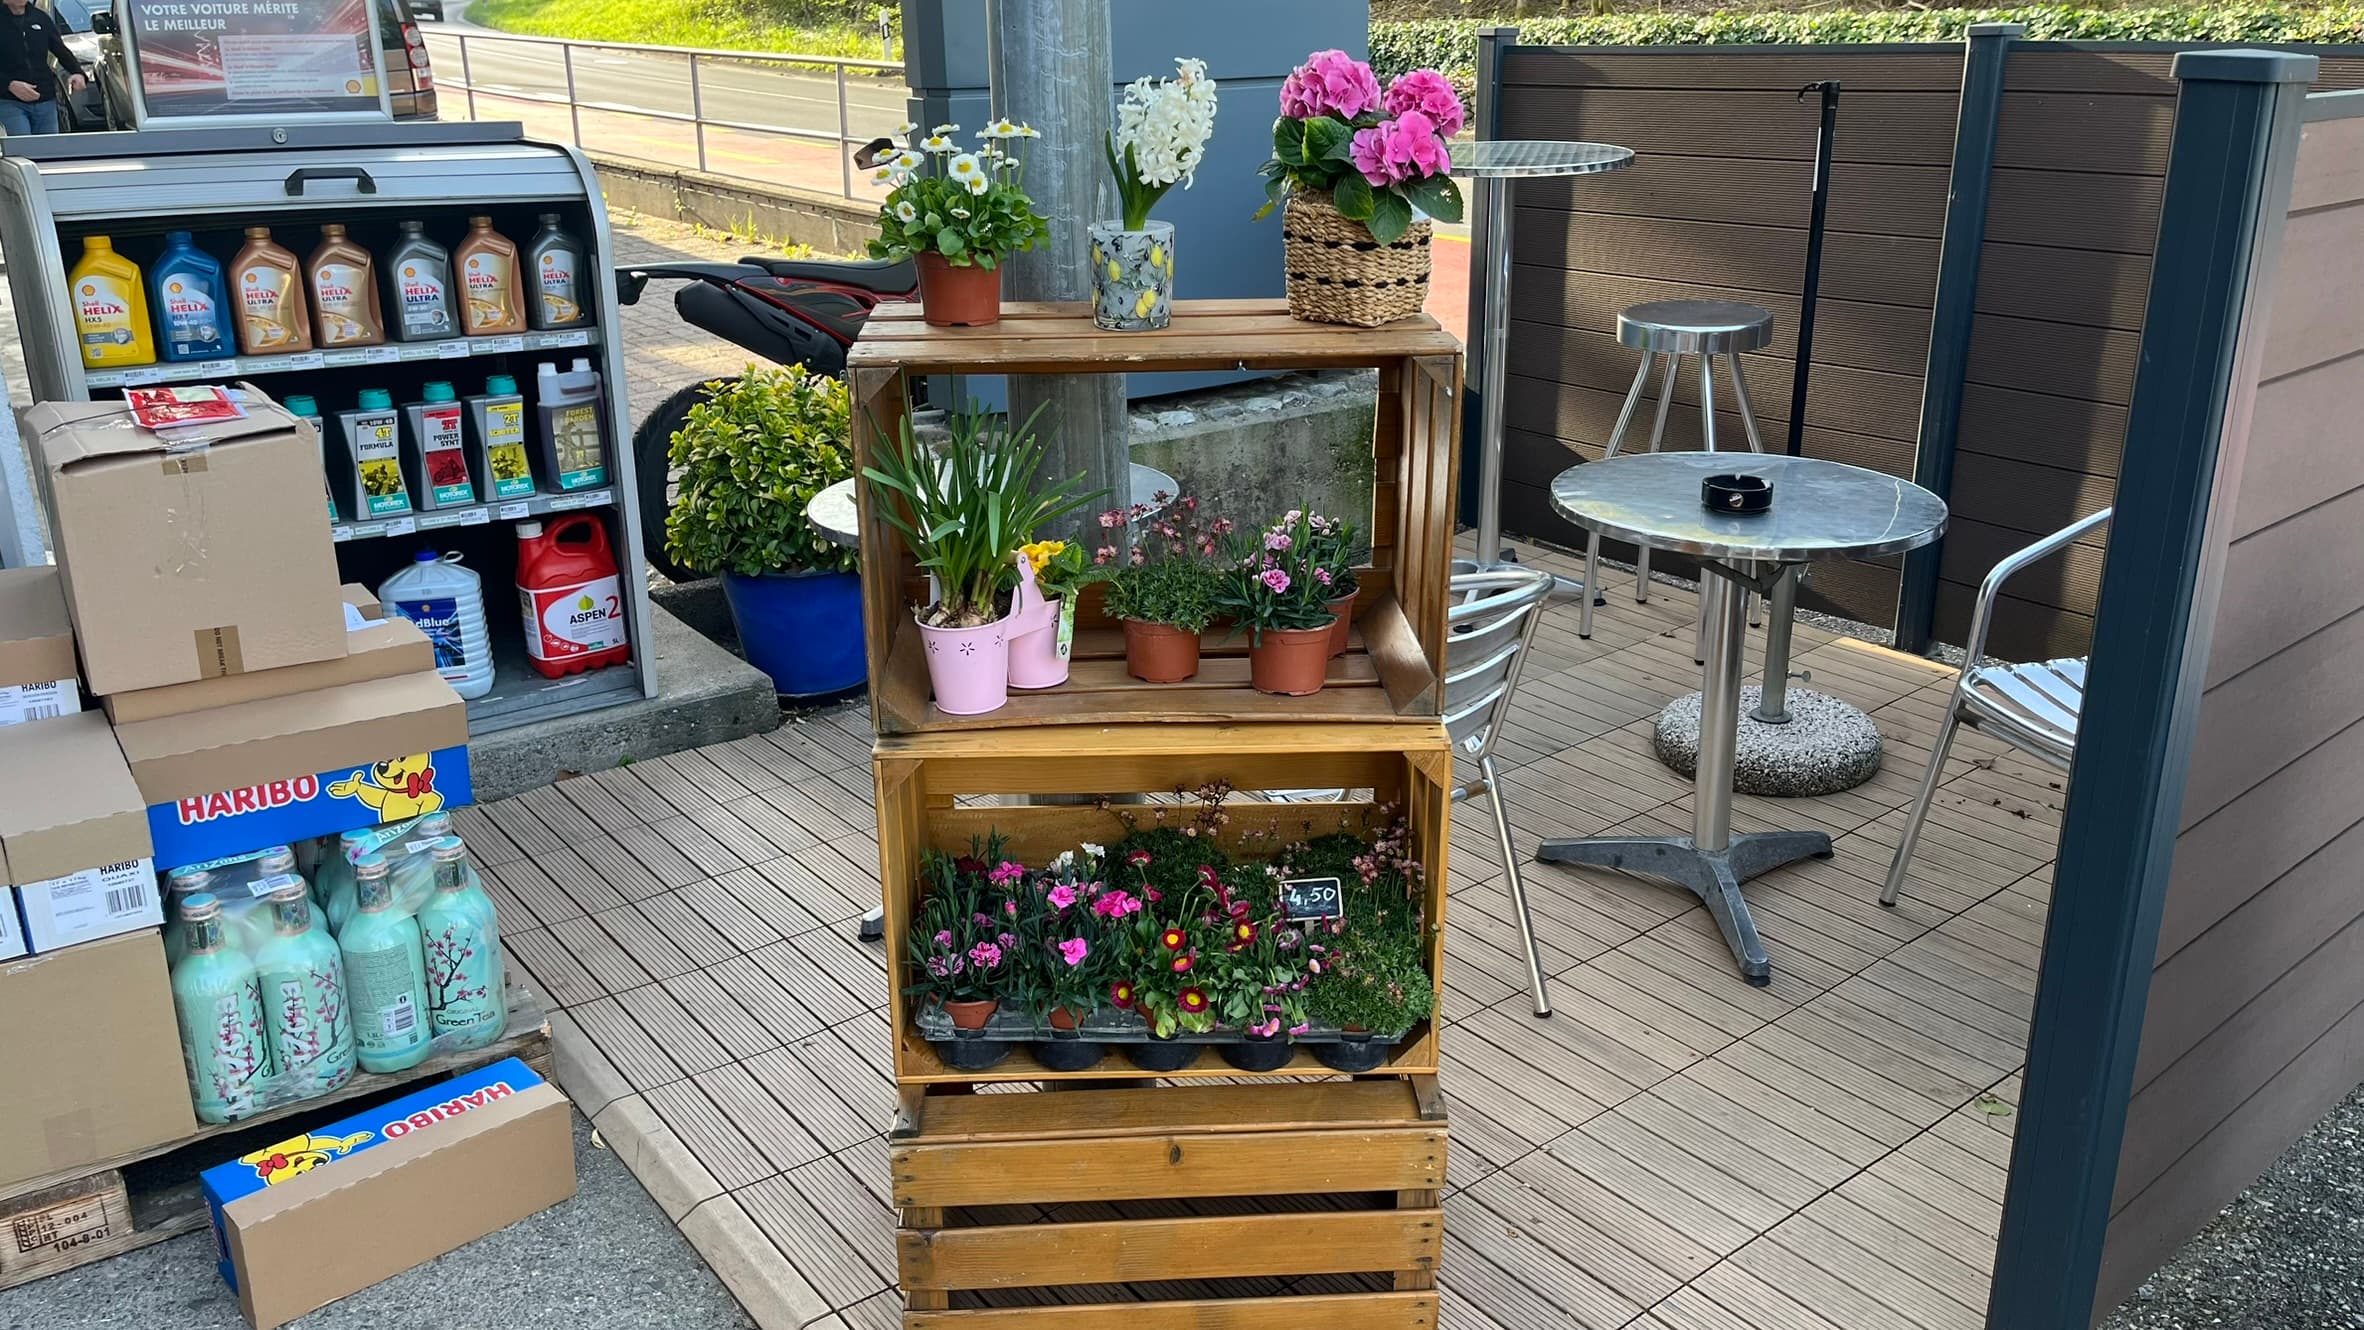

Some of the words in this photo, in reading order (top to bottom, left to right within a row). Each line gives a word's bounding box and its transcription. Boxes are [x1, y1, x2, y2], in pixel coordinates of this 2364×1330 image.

[141, 4, 187, 15] VOTRE
[190, 3, 248, 15] VOITURE
[253, 0, 299, 14] MÉRITE
[144, 20, 159, 30] LE
[164, 19, 227, 30] MEILLEUR
[321, 287, 352, 296] HELIX
[405, 286, 440, 295] HELIX
[406, 294, 439, 302] ULTRA
[83, 305, 124, 315] HELIX
[171, 304, 208, 312] HELIX
[503, 413, 519, 424] 2T
[375, 426, 392, 438] 4T
[433, 433, 460, 441] POWER
[360, 442, 394, 451] FORMULA
[501, 482, 529, 491] MOTOREX
[440, 489, 468, 498] MOTOREX
[373, 499, 404, 509] MOTOREX
[569, 608, 606, 625] ASPEN
[605, 595, 622, 619] 2
[415, 617, 450, 628] dBlue
[22, 680, 57, 693] HARIBO
[178, 774, 318, 824] HARIBO
[100, 859, 139, 876] HARIBO
[1290, 887, 1336, 906] 4,50
[436, 1013, 474, 1026] Green
[473, 1010, 495, 1023] Tea
[383, 1082, 513, 1138] HARIBO
[41, 1211, 88, 1231] 12-004
[54, 1227, 111, 1252] 104-8-01
